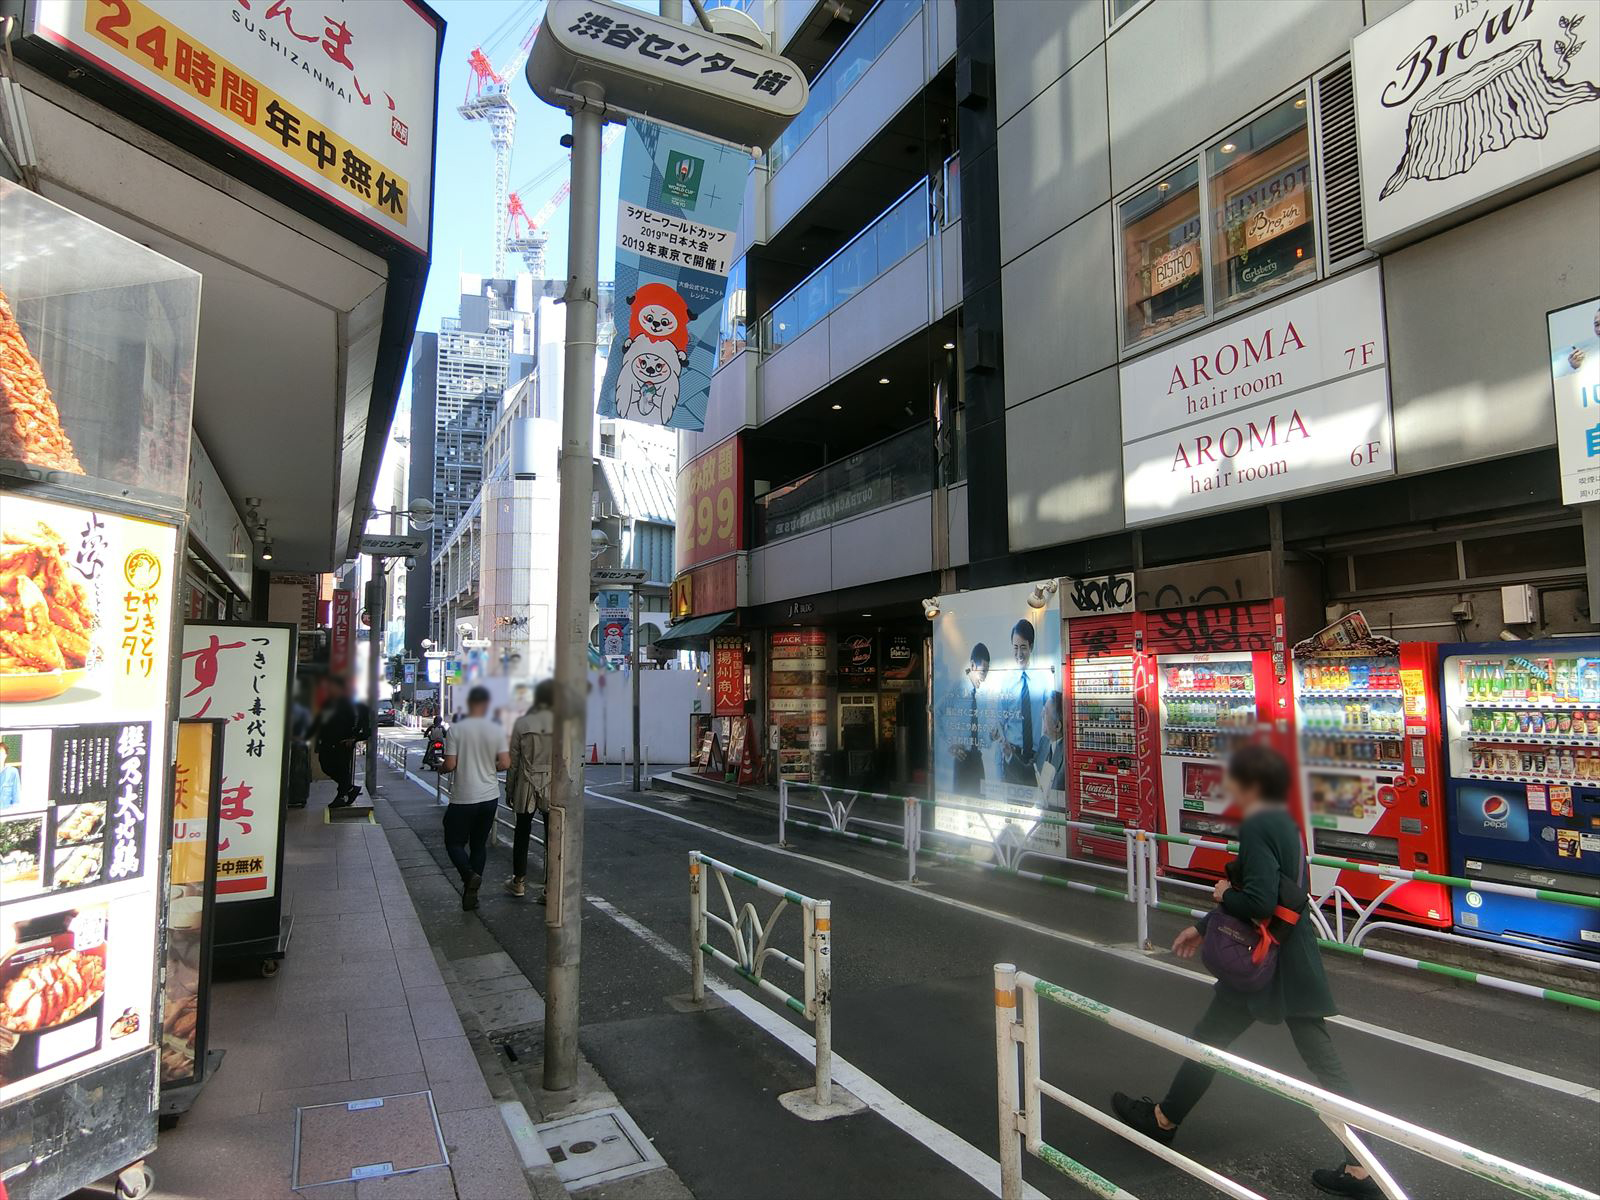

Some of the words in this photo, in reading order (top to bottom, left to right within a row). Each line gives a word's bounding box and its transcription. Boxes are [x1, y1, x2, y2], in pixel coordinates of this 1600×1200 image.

[231, 9, 353, 104] SUSHIZANMAI
[239, 0, 396, 110] んまい
[568, 11, 792, 96] 渋谷センター街
[95, 0, 258, 126] 24時間
[264, 99, 404, 215] 年中無休
[626, 206, 727, 242] ラグビーワールドカップ
[1249, 205, 1300, 236] Brown
[1156, 251, 1192, 283] BISTRO
[1242, 260, 1277, 283] Carlsberg
[1167, 321, 1306, 395] AROMA
[1344, 342, 1375, 370] 7F
[1187, 395, 1228, 414] hair
[1233, 371, 1283, 400] room
[1171, 409, 1311, 472] AROMA
[1350, 441, 1381, 467] 6F
[1190, 470, 1231, 494] hair
[1237, 458, 1288, 484] room
[684, 487, 734, 552] 299
[122, 591, 141, 676] センター
[141, 591, 158, 678] やきとり
[245, 637, 271, 757] つきじ喜代村
[716, 651, 734, 707] 揚州商人
[733, 652, 742, 706] 中国ラーメン
[1483, 820, 1508, 829] pepsi
